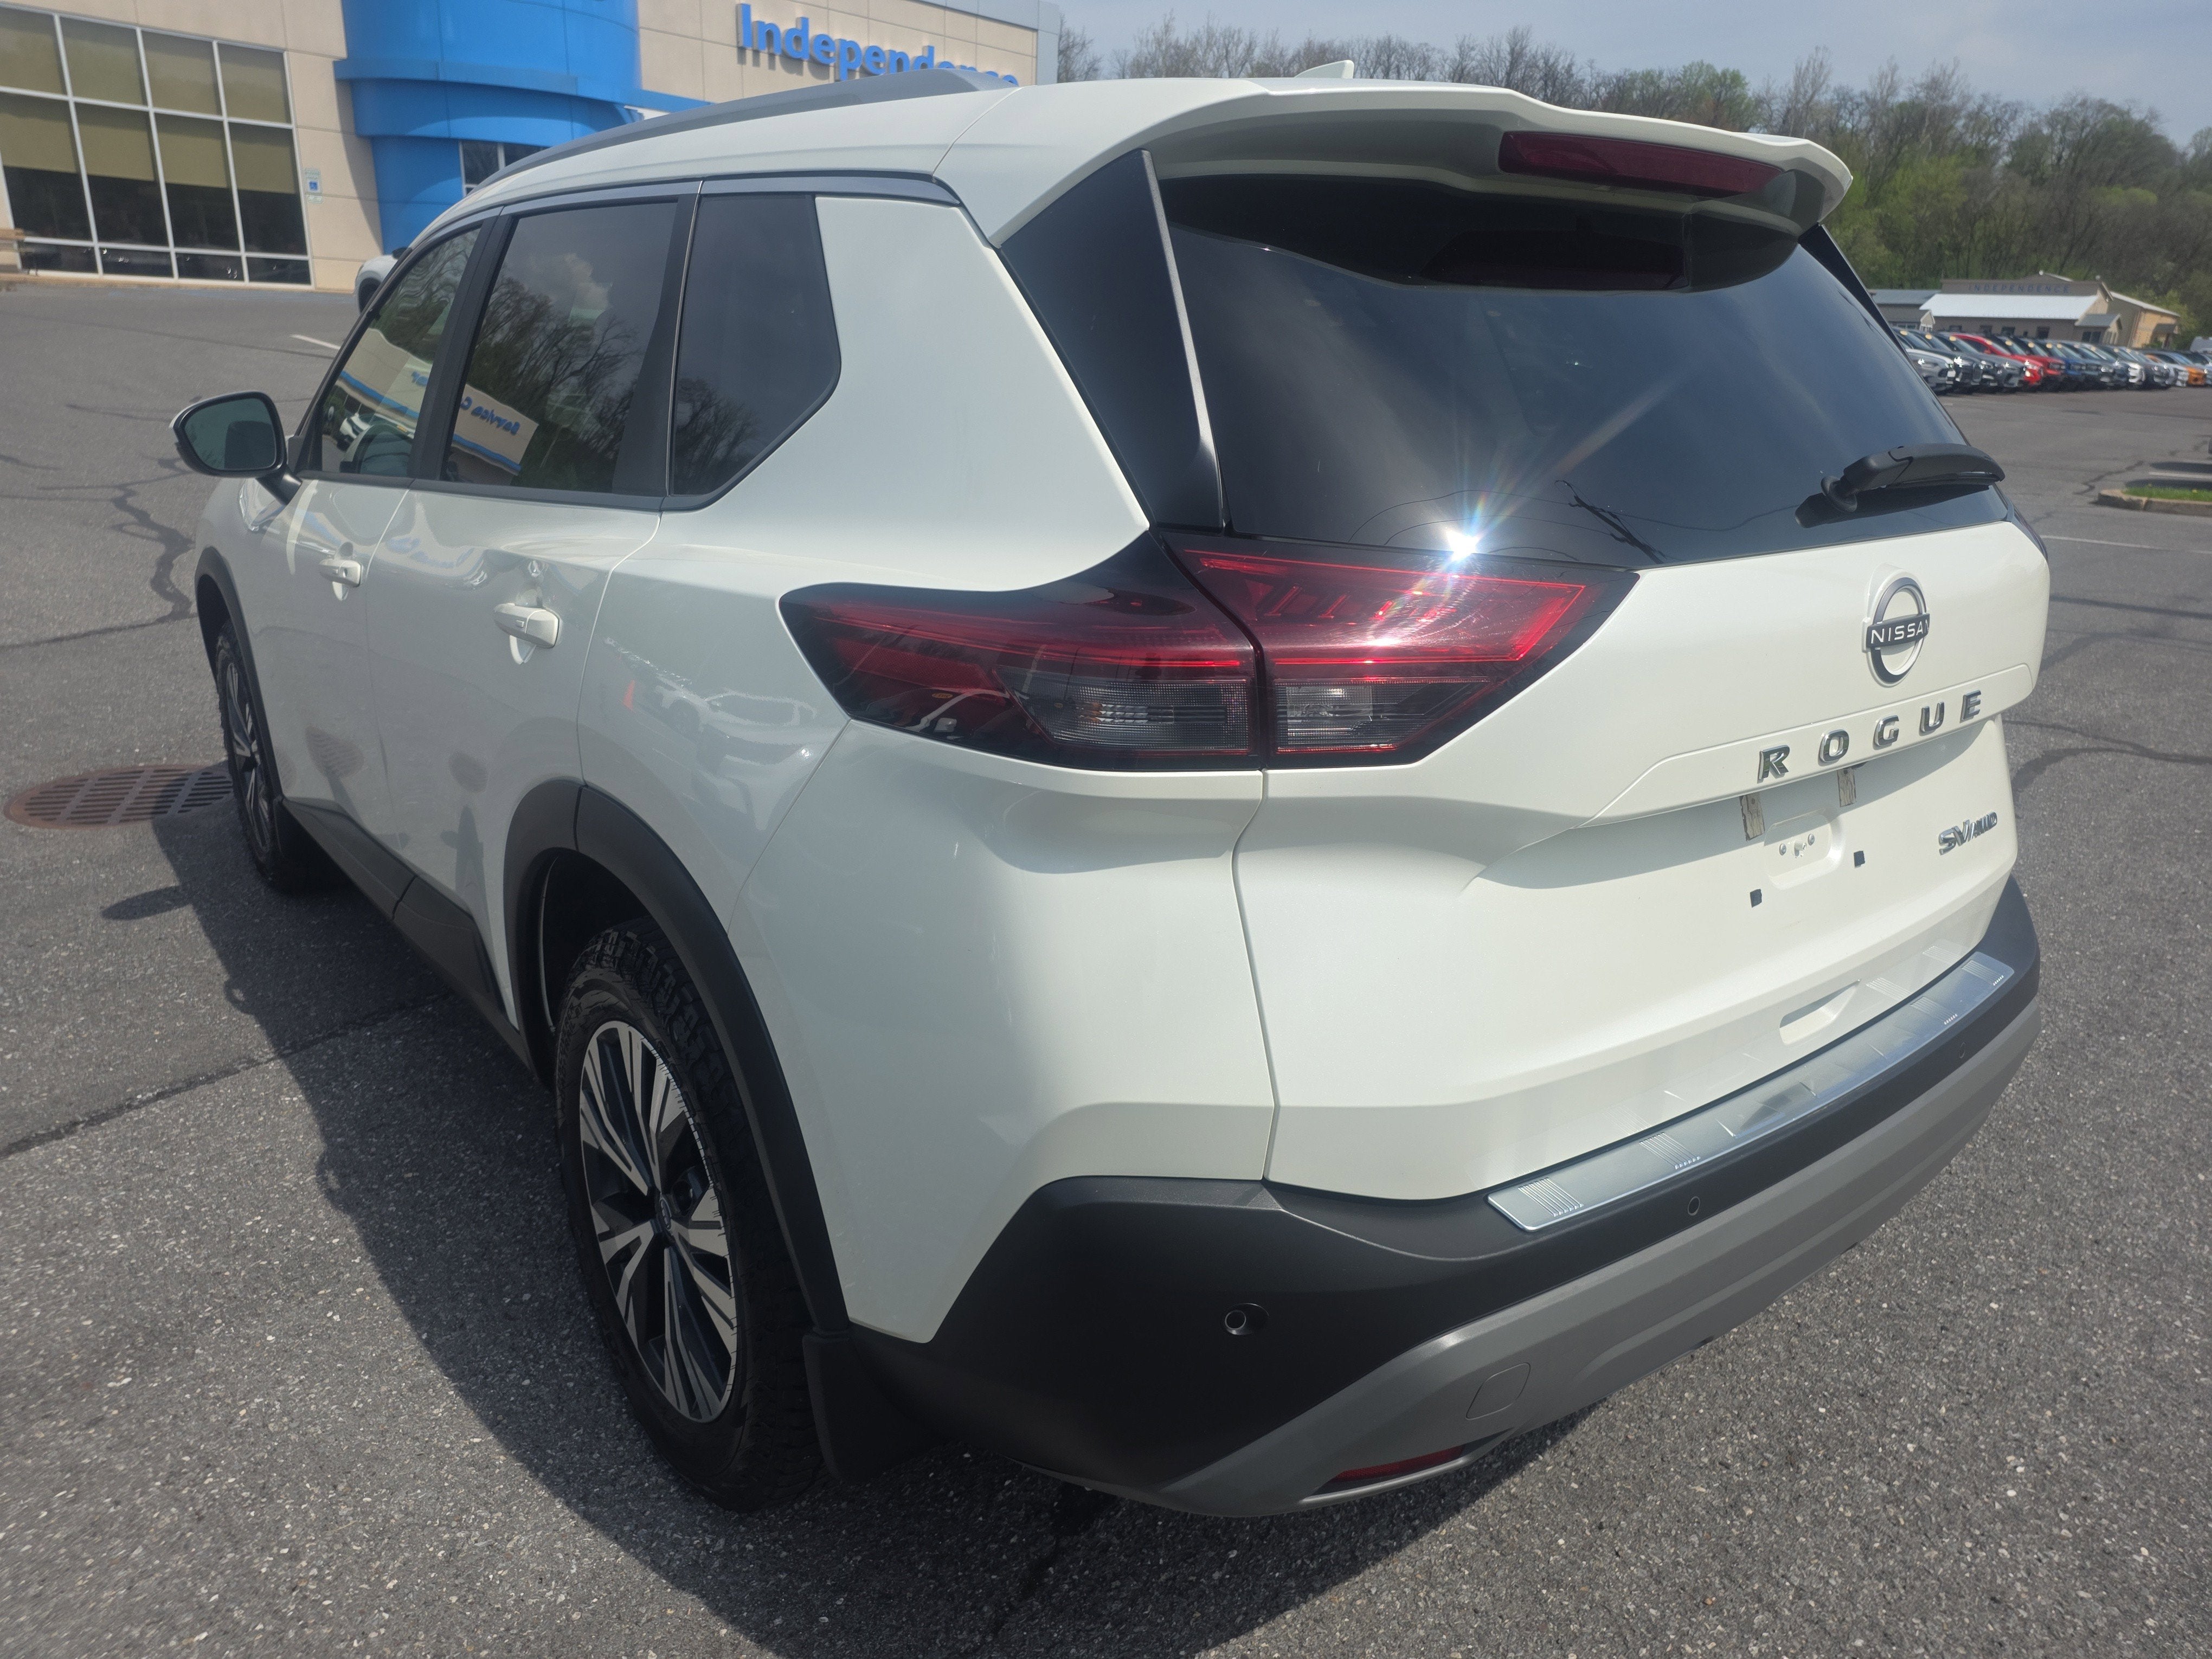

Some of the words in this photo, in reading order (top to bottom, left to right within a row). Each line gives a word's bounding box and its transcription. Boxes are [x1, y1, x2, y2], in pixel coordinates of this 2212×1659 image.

[736, 3, 1019, 86] Independ
[1969, 283, 2070, 293] INDEPENDENCE
[1870, 619, 1930, 644] NISSAN
[1758, 690, 1981, 783] ROGUE
[1938, 819, 1970, 856] SV
